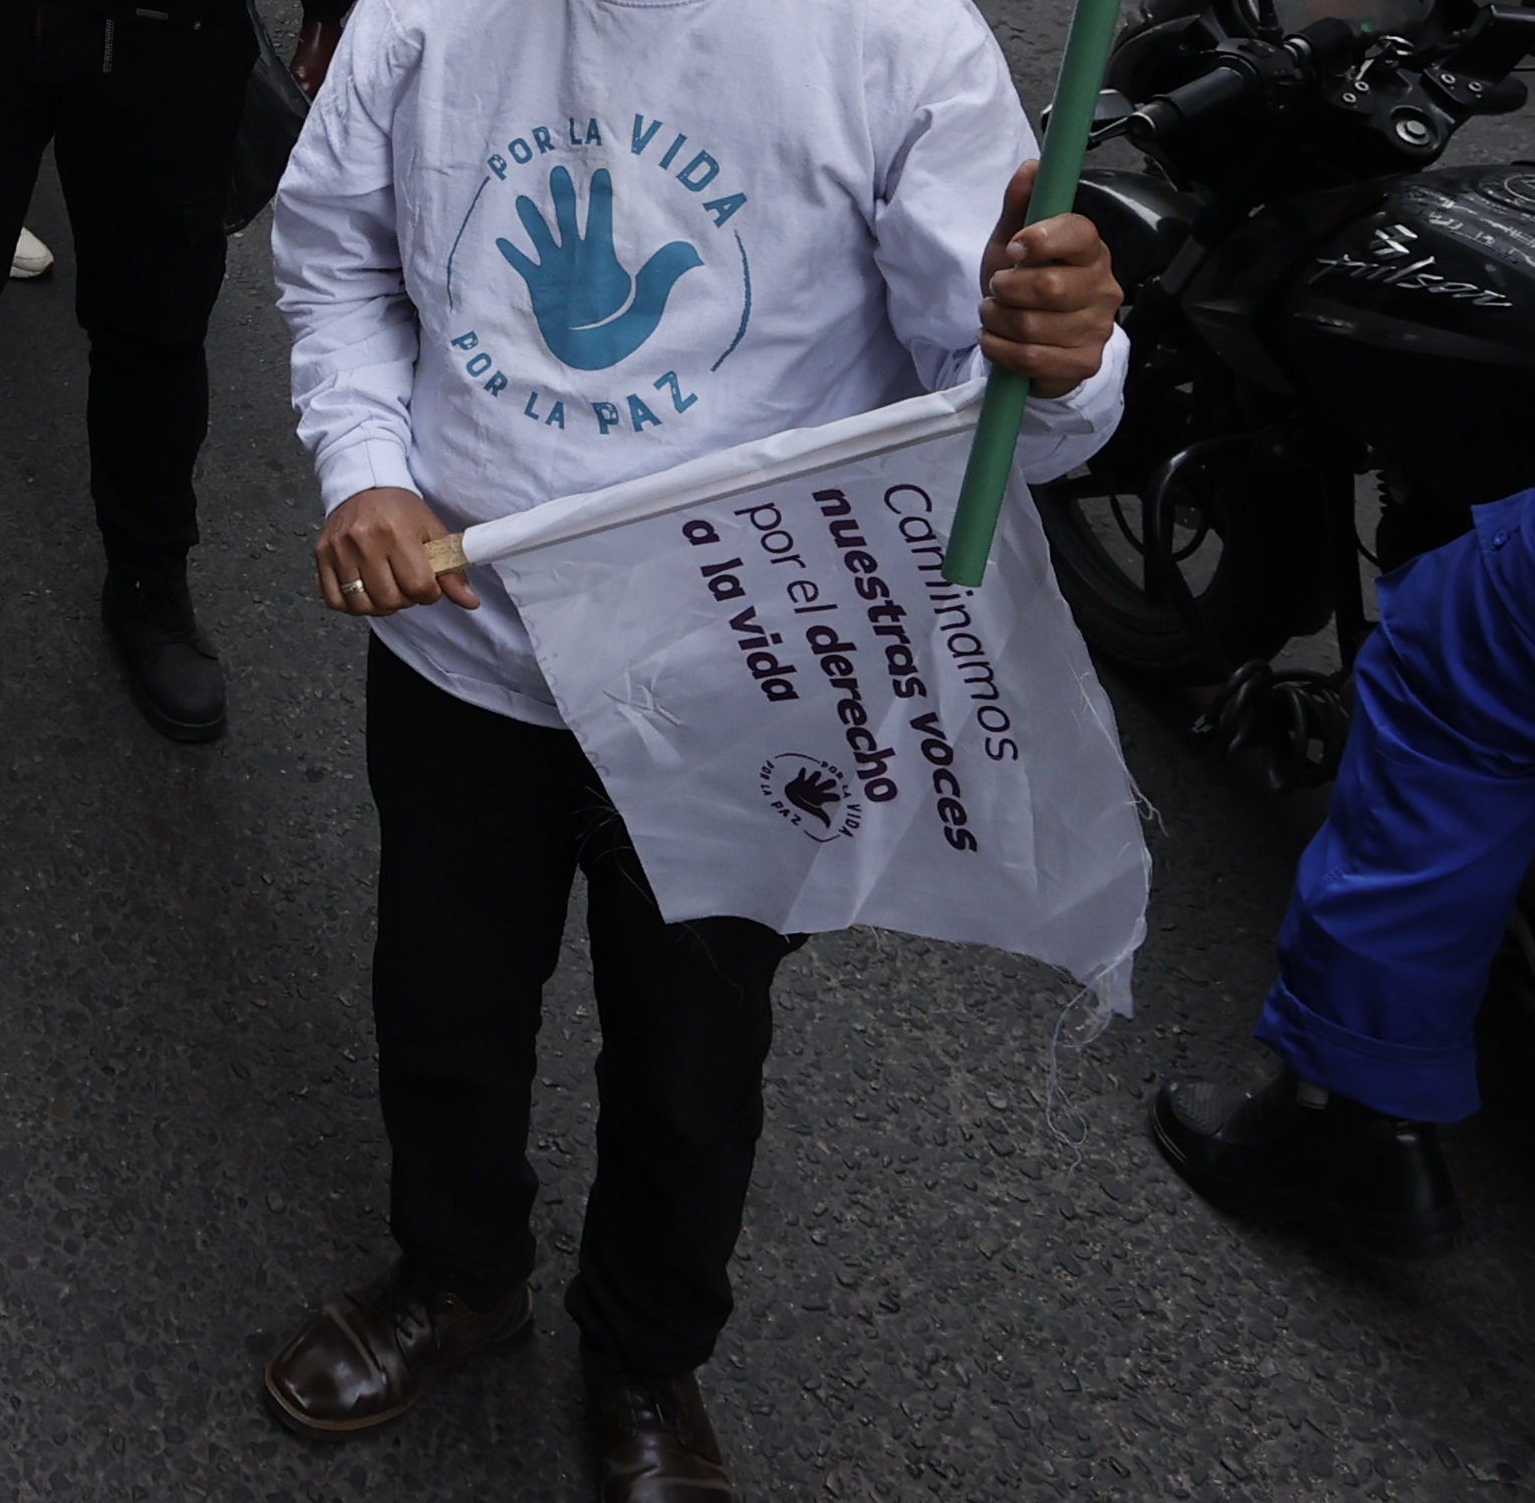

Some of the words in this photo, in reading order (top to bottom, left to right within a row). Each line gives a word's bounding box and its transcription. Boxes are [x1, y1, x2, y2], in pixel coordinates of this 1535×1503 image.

[486, 124, 557, 181] POR
[568, 117, 603, 147] LA
[630, 113, 748, 229] VIDA
[450, 330, 509, 398] POR
[523, 391, 566, 430] LA
[591, 370, 699, 435] PAZ
[681, 518, 721, 547] a
[734, 500, 807, 570] por
[699, 557, 746, 602] la
[786, 578, 839, 615] el
[729, 604, 801, 703] vida
[811, 488, 928, 700] nuestras
[908, 710, 979, 854] voces
[804, 624, 898, 804] derecho
[759, 760, 775, 780] POR
[821, 761, 844, 779] POR
[760, 784, 773, 796] LA
[842, 784, 852, 799] LA
[770, 800, 802, 826] PAZ
[838, 804, 862, 838] VIDA
